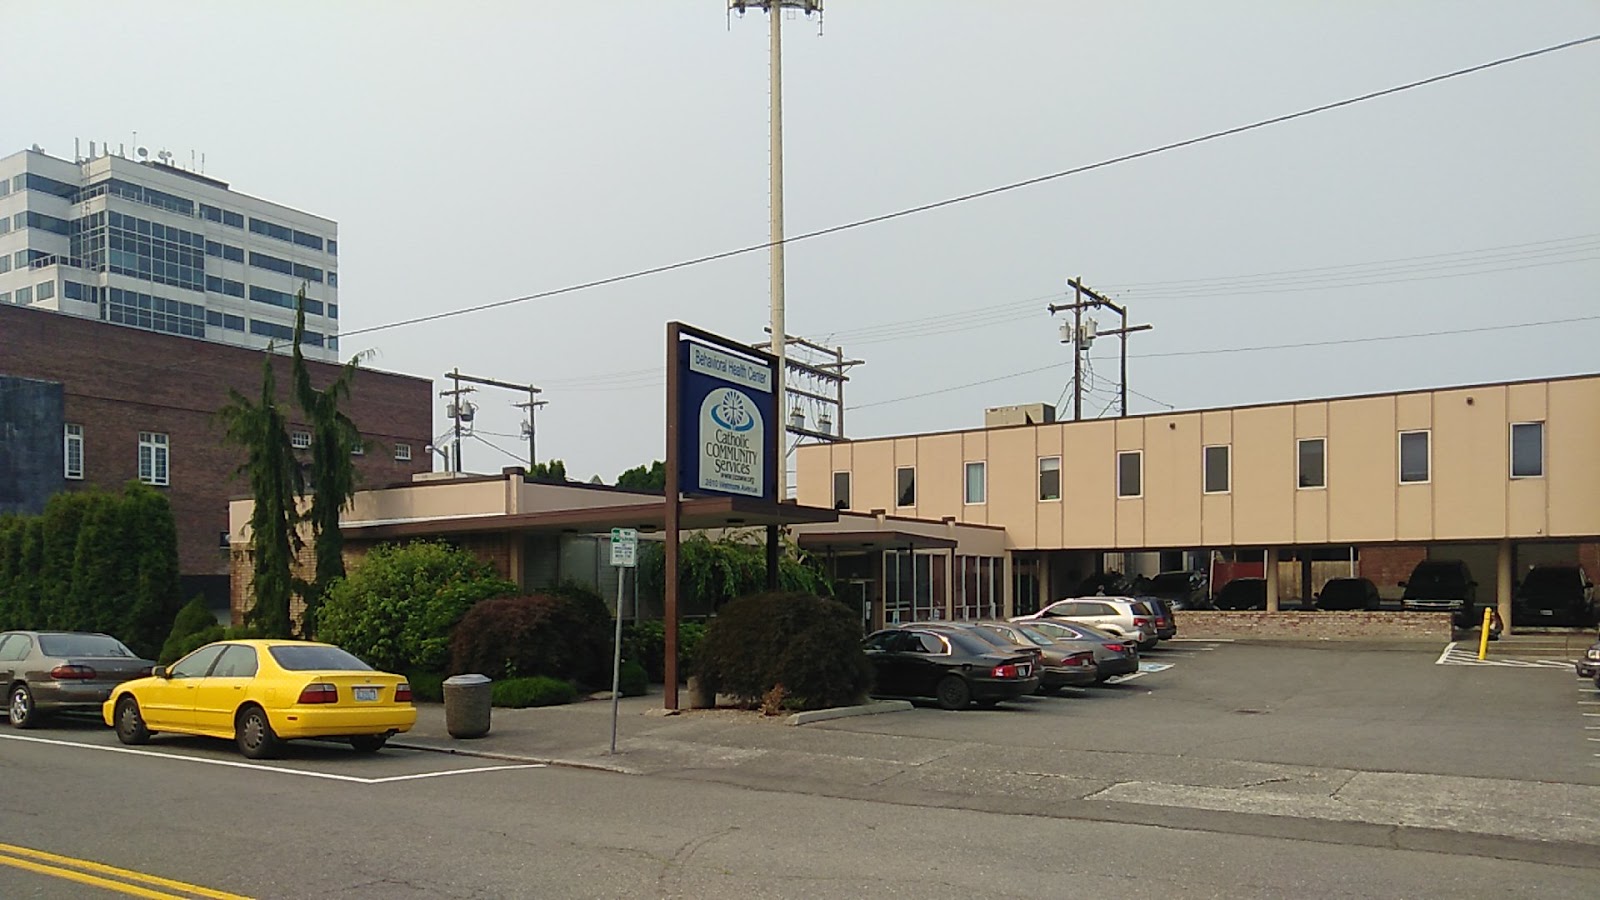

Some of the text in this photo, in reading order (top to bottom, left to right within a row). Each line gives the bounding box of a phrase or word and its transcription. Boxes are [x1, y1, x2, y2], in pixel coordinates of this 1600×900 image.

[695, 349, 767, 384] Behavioral Health Center
[715, 428, 750, 449] Catholic
[706, 442, 758, 465] COMMUNITY
[714, 459, 751, 475] Services
